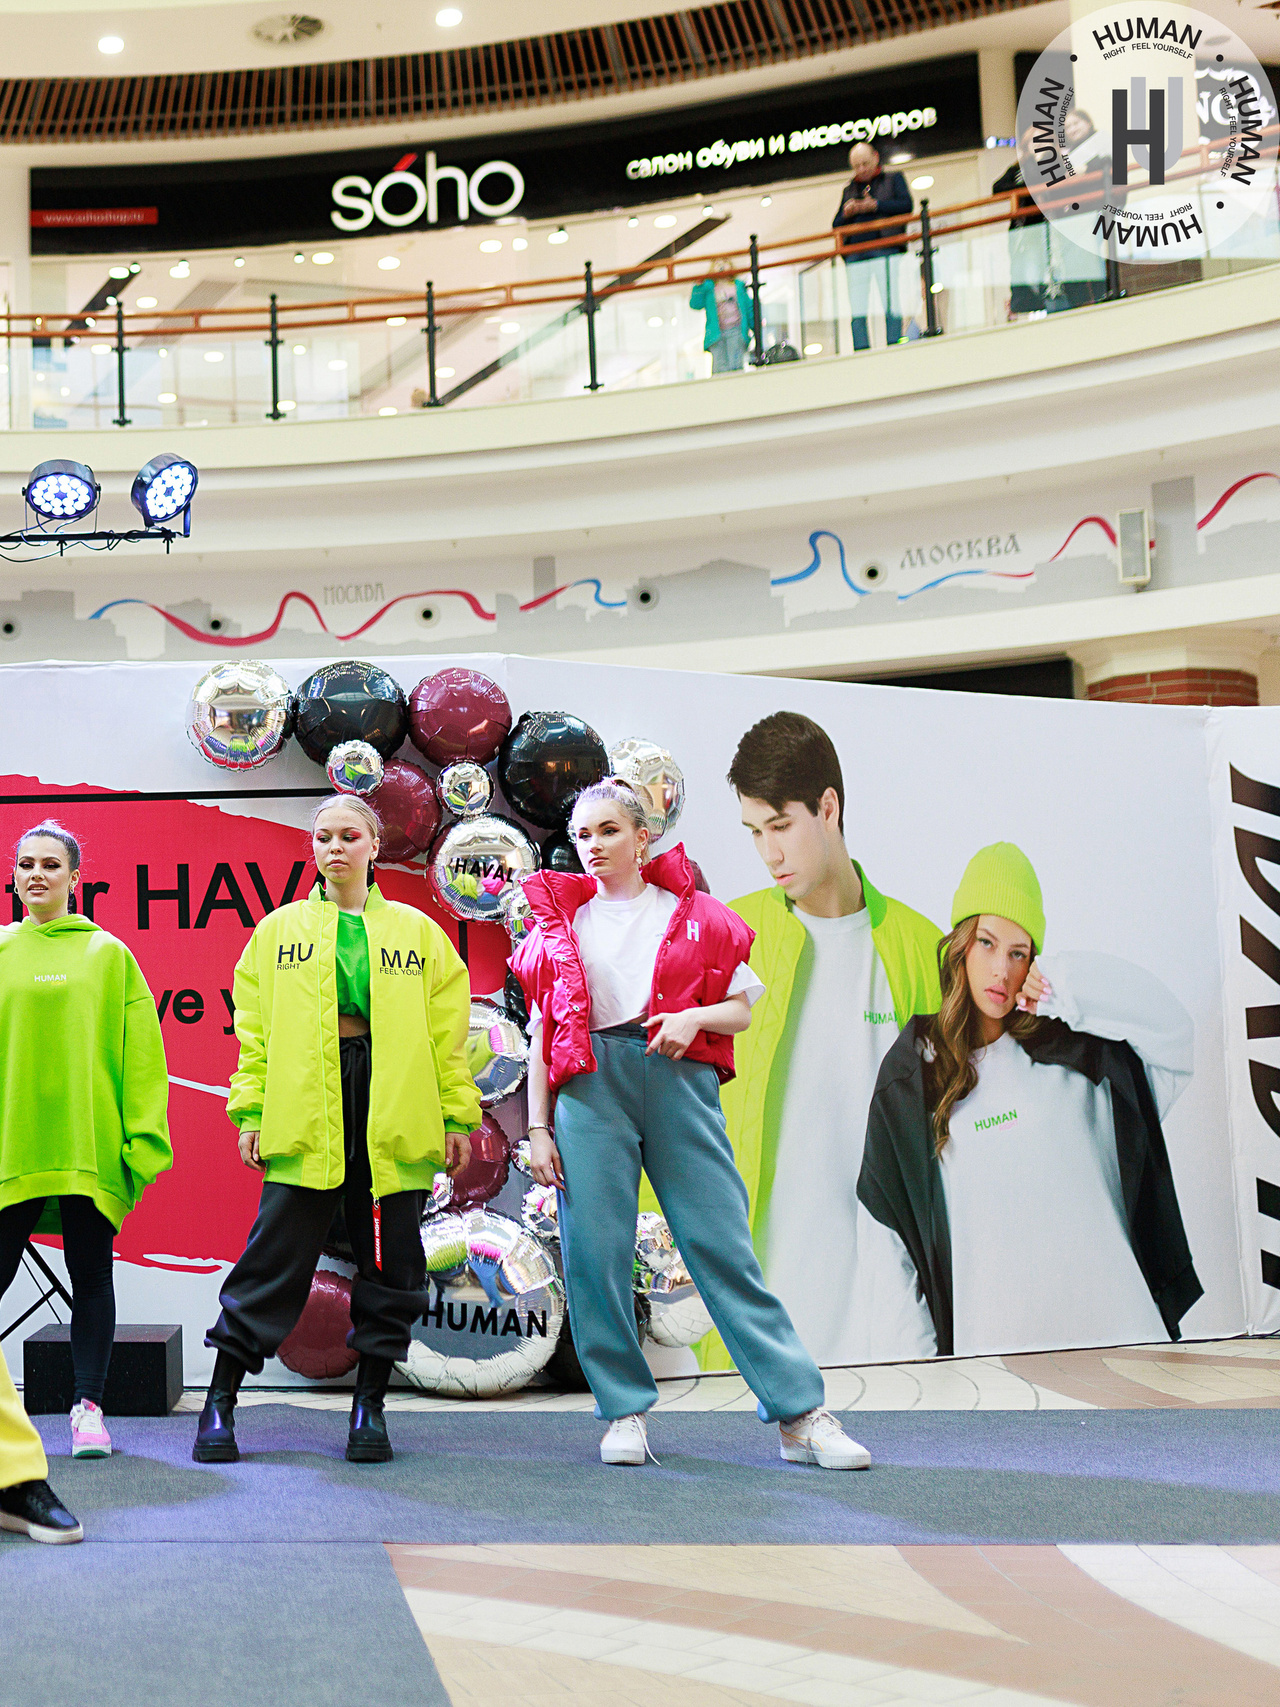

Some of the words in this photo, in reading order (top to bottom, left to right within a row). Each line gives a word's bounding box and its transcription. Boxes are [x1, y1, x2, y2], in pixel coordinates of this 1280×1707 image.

[626, 150, 693, 180] салон
[696, 139, 765, 169] обуви
[768, 134, 785, 157] и
[788, 107, 938, 153] аксессуаров
[900, 532, 1020, 569] МОСКВА
[454, 857, 513, 884] HAVAL
[278, 943, 314, 964] HU
[34, 974, 67, 982] HUMAN
[380, 967, 399, 975] FEEL
[974, 1109, 1018, 1132] HUMAN
[422, 1299, 548, 1339] HUMAN
